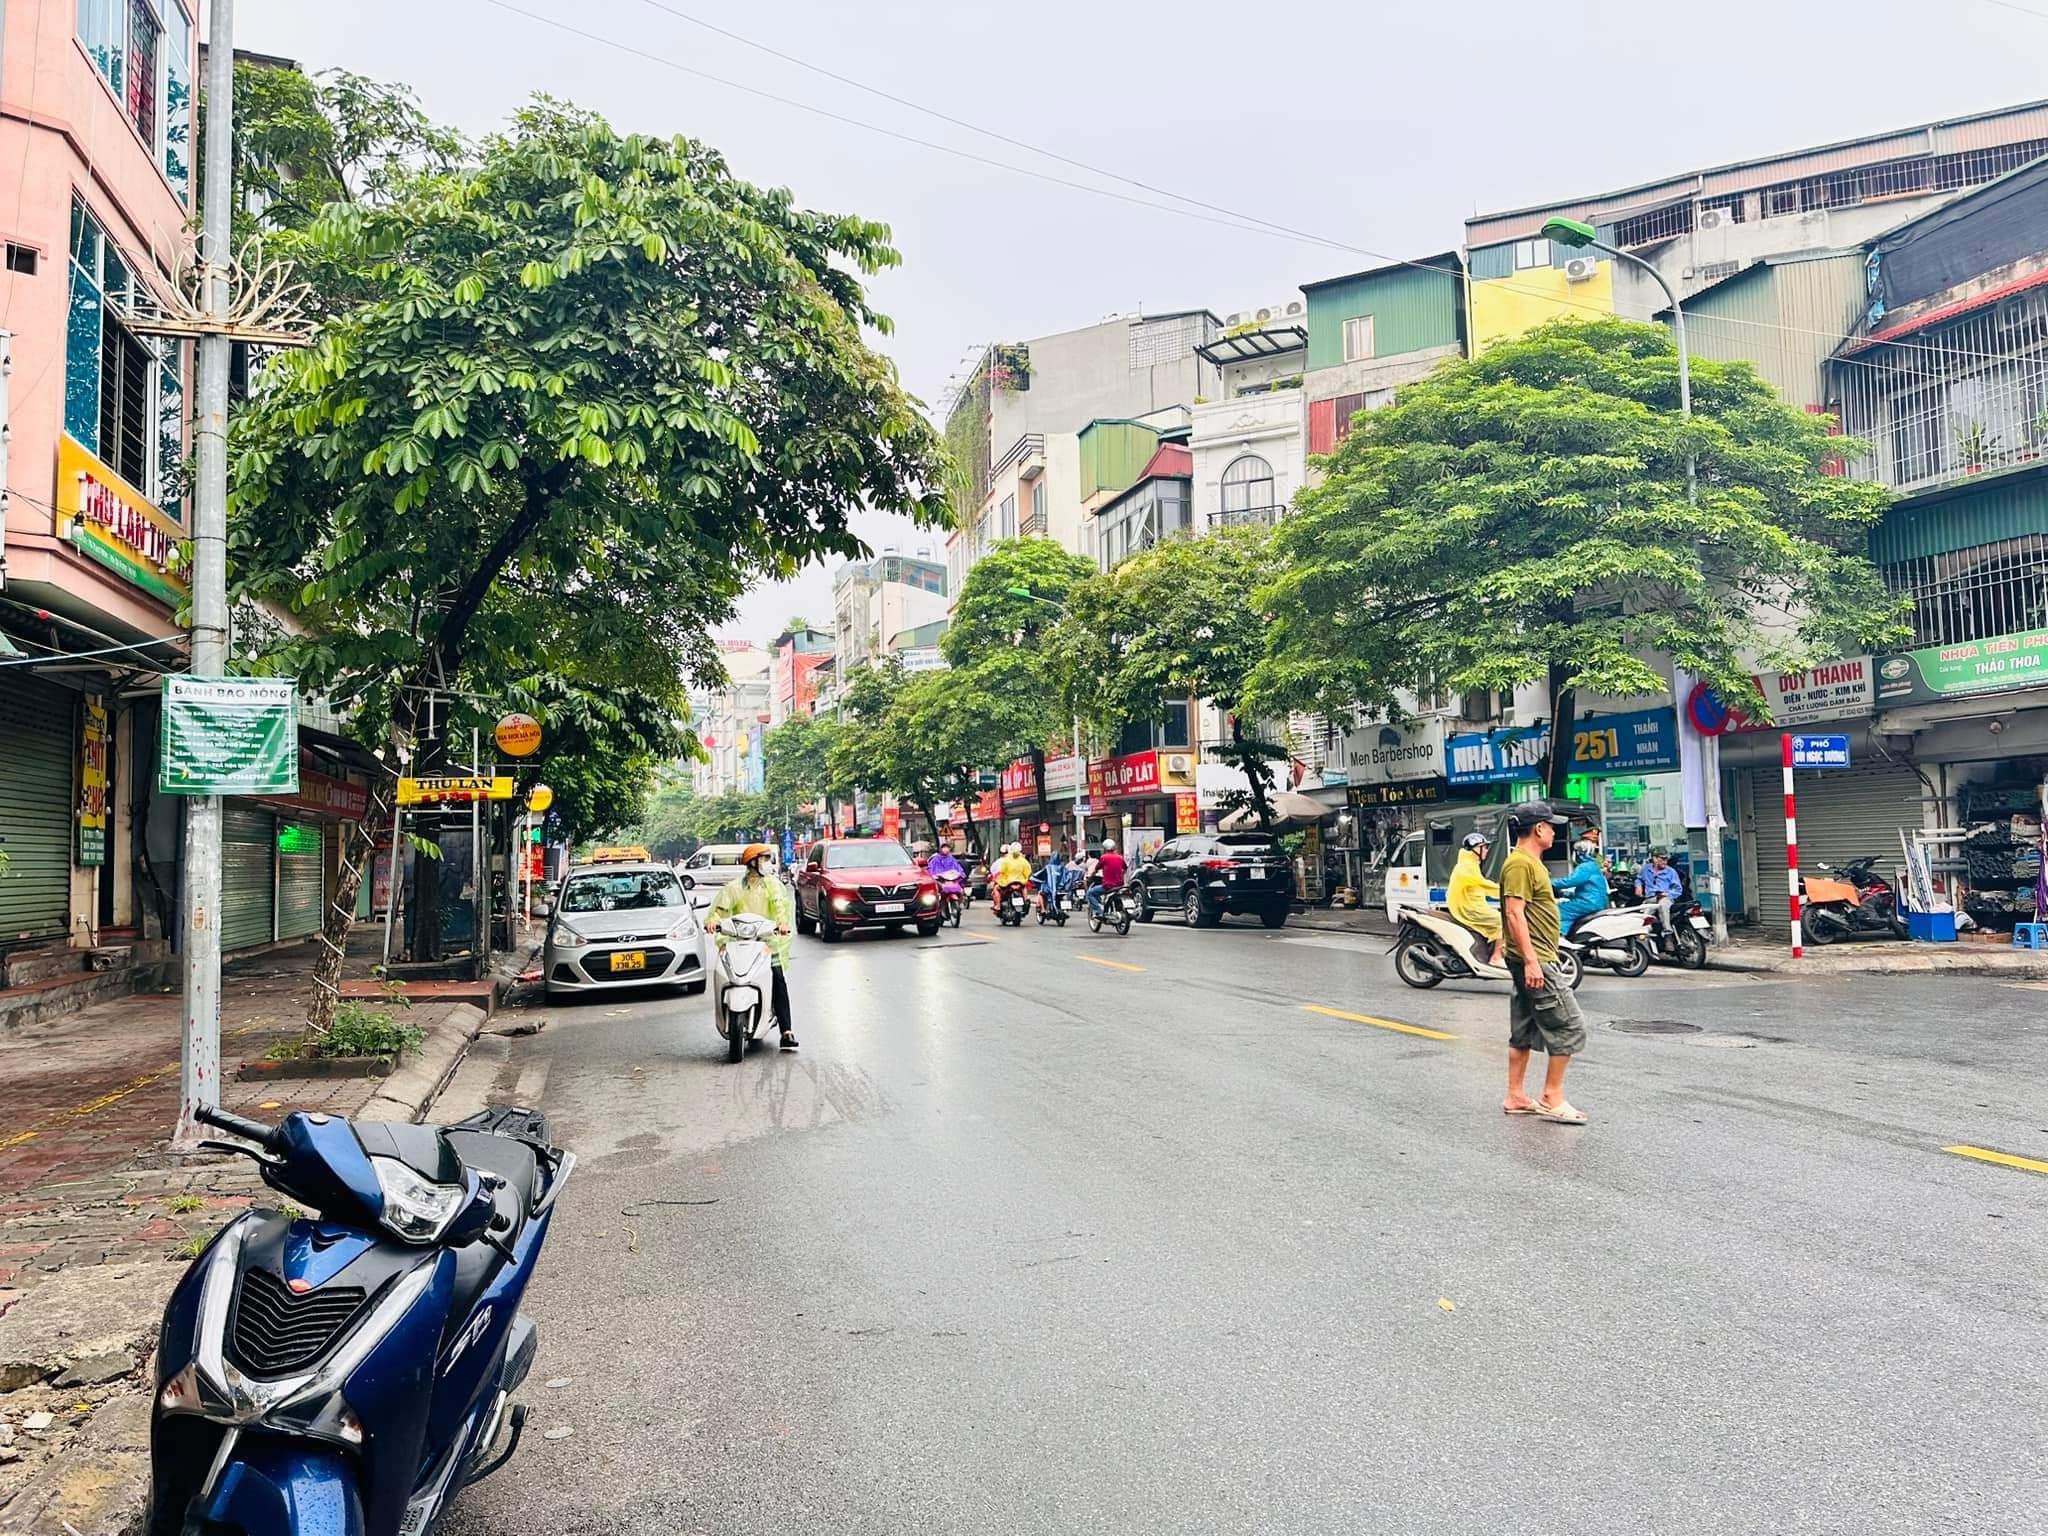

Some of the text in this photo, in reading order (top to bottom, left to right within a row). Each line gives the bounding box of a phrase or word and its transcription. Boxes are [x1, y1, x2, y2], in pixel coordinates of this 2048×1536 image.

[1940, 646, 1979, 662] NHỰA
[1811, 661, 1863, 686] THANH
[1975, 655, 2041, 675] THẢO THOA
[217, 688, 245, 698] BAO
[249, 688, 287, 699] NÓNG
[1835, 686, 1851, 697] KIM
[1853, 682, 1866, 693] KHÍ
[1574, 728, 1619, 762] 251
[1810, 738, 1830, 748] PHỐ
[1350, 742, 1433, 767] Men Barbershop
[1453, 738, 1494, 773] NHÀ
[416, 778, 493, 789] THU LAN
[1105, 760, 1154, 787] ĐÁ ỐP LÁT
